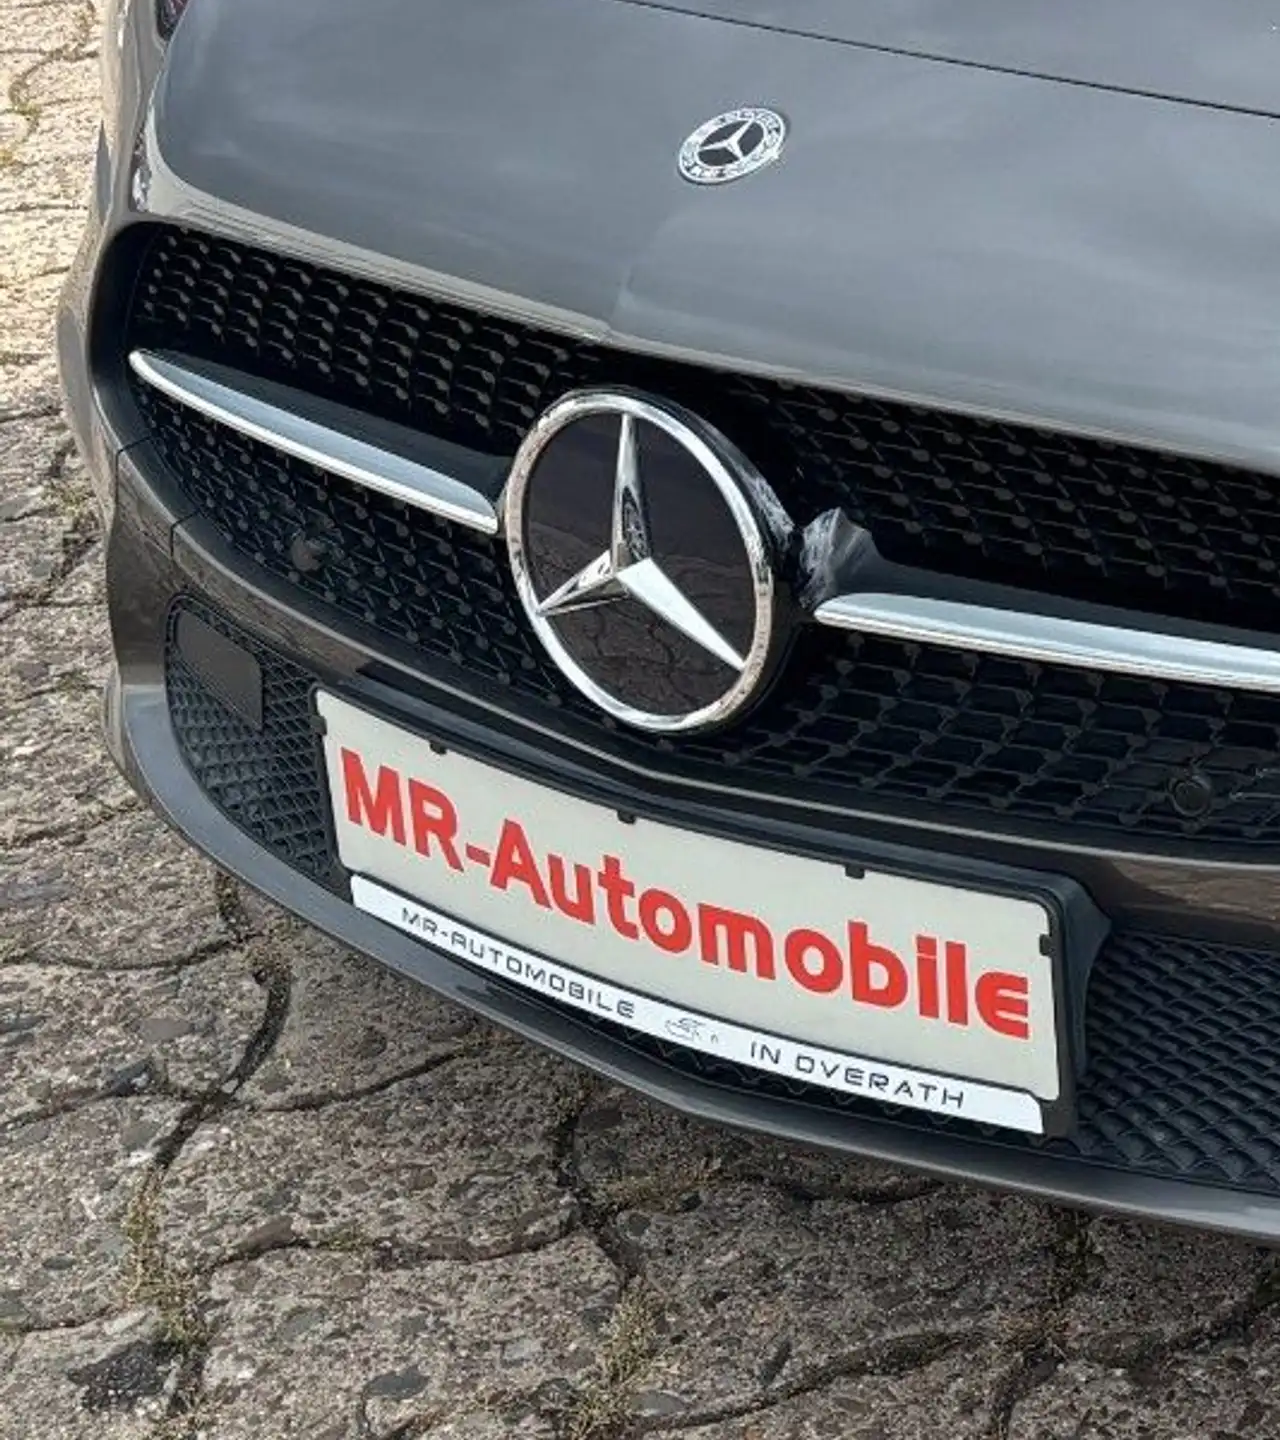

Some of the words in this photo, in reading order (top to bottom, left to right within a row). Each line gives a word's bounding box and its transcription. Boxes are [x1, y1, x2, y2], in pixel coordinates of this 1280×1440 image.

[340, 746, 1031, 1040] MR-Automobile
[402, 907, 635, 1019] MR-AUTOMOBILE
[750, 1040, 781, 1065] IN
[795, 1055, 964, 1110] OVERATH
